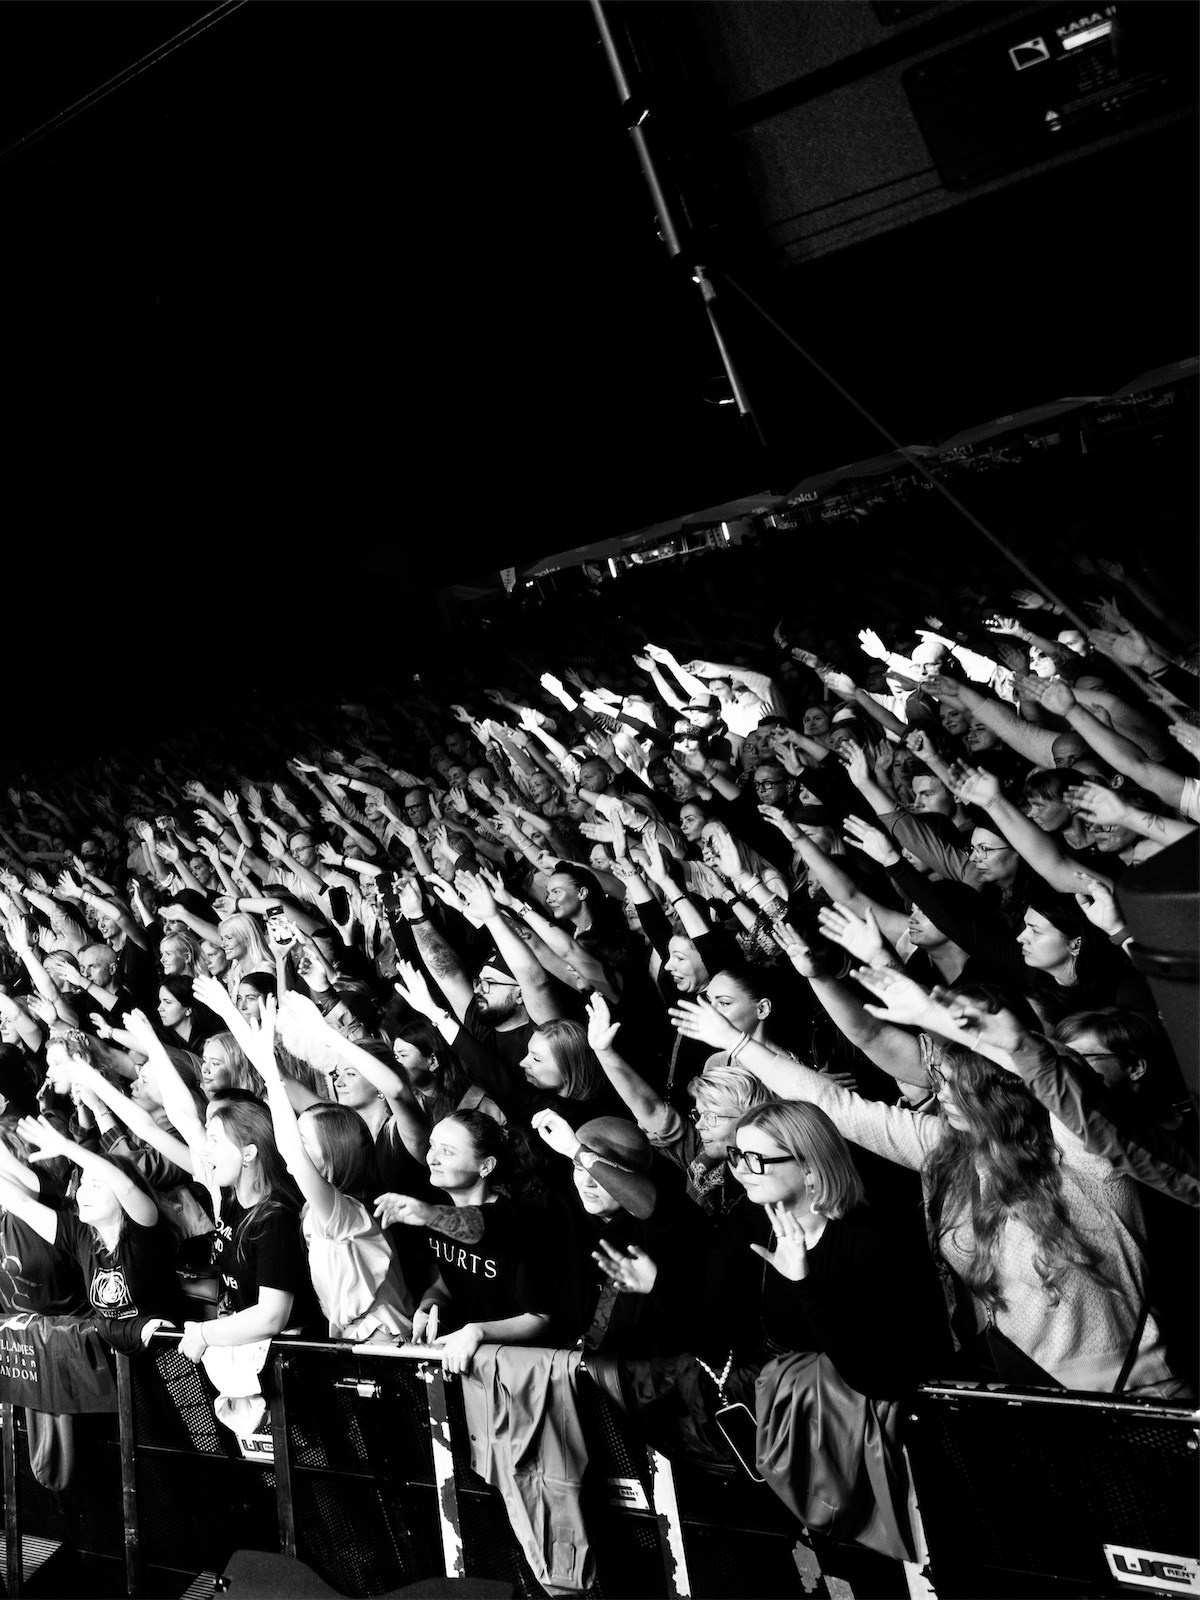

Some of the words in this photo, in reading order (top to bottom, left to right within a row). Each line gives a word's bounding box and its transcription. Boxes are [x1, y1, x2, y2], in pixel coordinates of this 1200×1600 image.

[1056, 13, 1102, 37] KARA
[787, 491, 818, 507] saku
[429, 1237, 497, 1279] HURTS
[1112, 1553, 1193, 1586] UC
[1166, 1568, 1197, 1580] RENT
